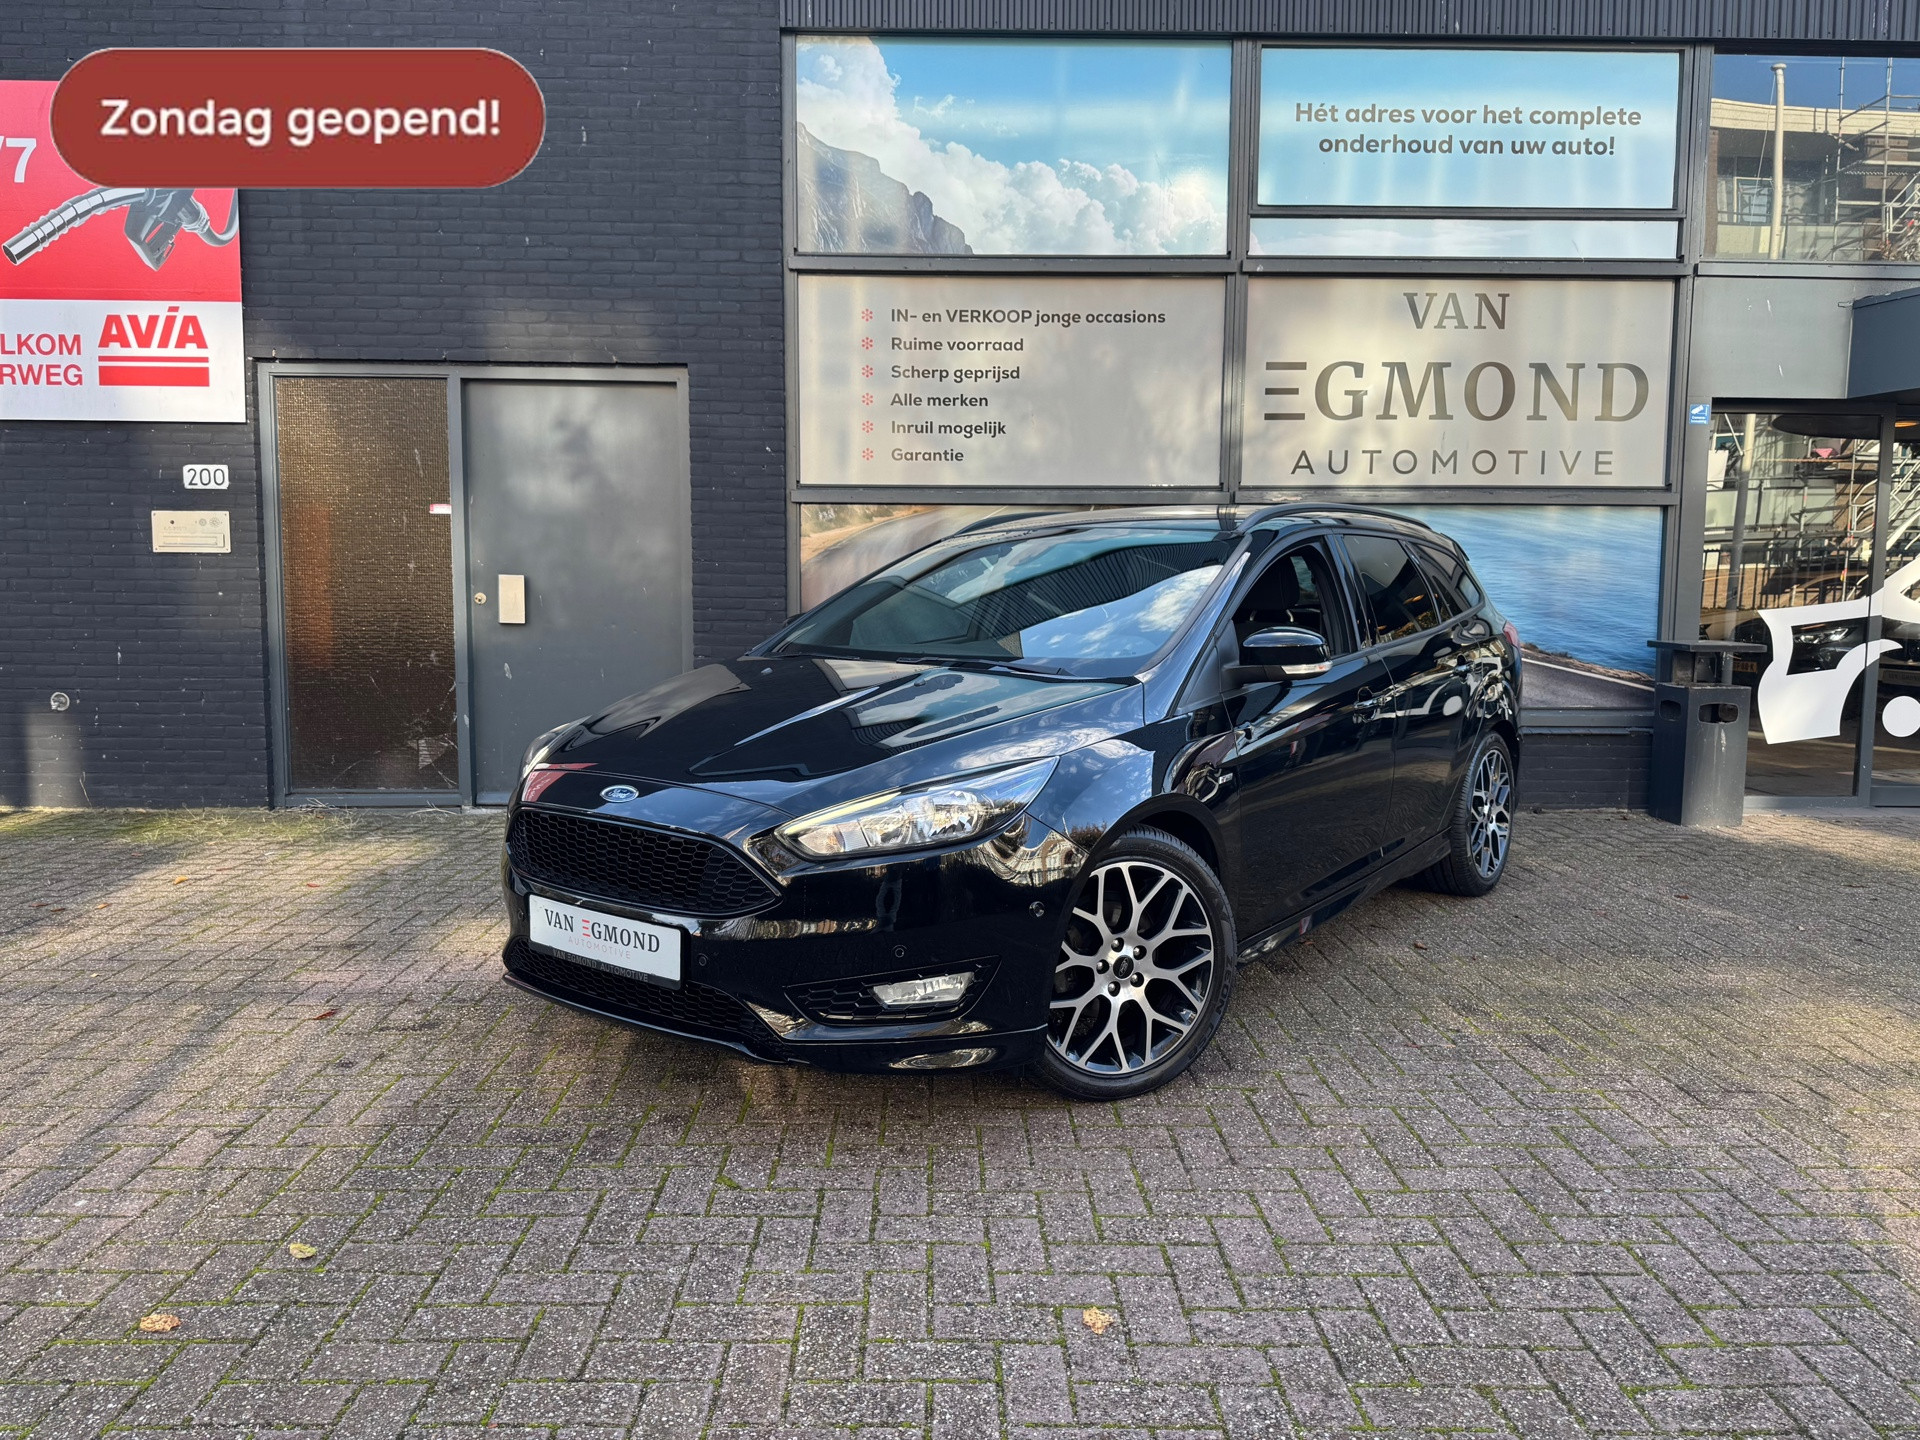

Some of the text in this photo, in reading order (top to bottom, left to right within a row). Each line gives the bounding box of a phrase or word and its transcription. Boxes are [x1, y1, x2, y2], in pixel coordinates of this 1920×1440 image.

[1295, 103, 1642, 131] Hét adres voor het complete
[1318, 134, 1616, 156] onderhoud van uw auto!
[891, 309, 1166, 328] IN- en VERKOOP jonge occasions
[1403, 292, 1510, 330] VAN
[98, 306, 209, 349] AVIA
[0, 333, 82, 356] LKOM
[891, 337, 1024, 352] Ruime voorraad
[0, 363, 83, 386] RWEG
[891, 365, 1020, 383] Scherp geprijsd
[890, 393, 989, 407] Alle merken
[1264, 361, 1649, 422] EGMOND
[891, 420, 1007, 439] Inruil mogelijk
[891, 448, 964, 462] Garantie
[1290, 449, 1613, 476] AUTOMOTIVE
[187, 468, 225, 486] 200
[544, 908, 661, 953] VAN EGMOND
[568, 935, 632, 960] AUTOMOTIVE
[552, 949, 567, 961] VAN
[600, 962, 649, 983] AUTOMOTIVE
